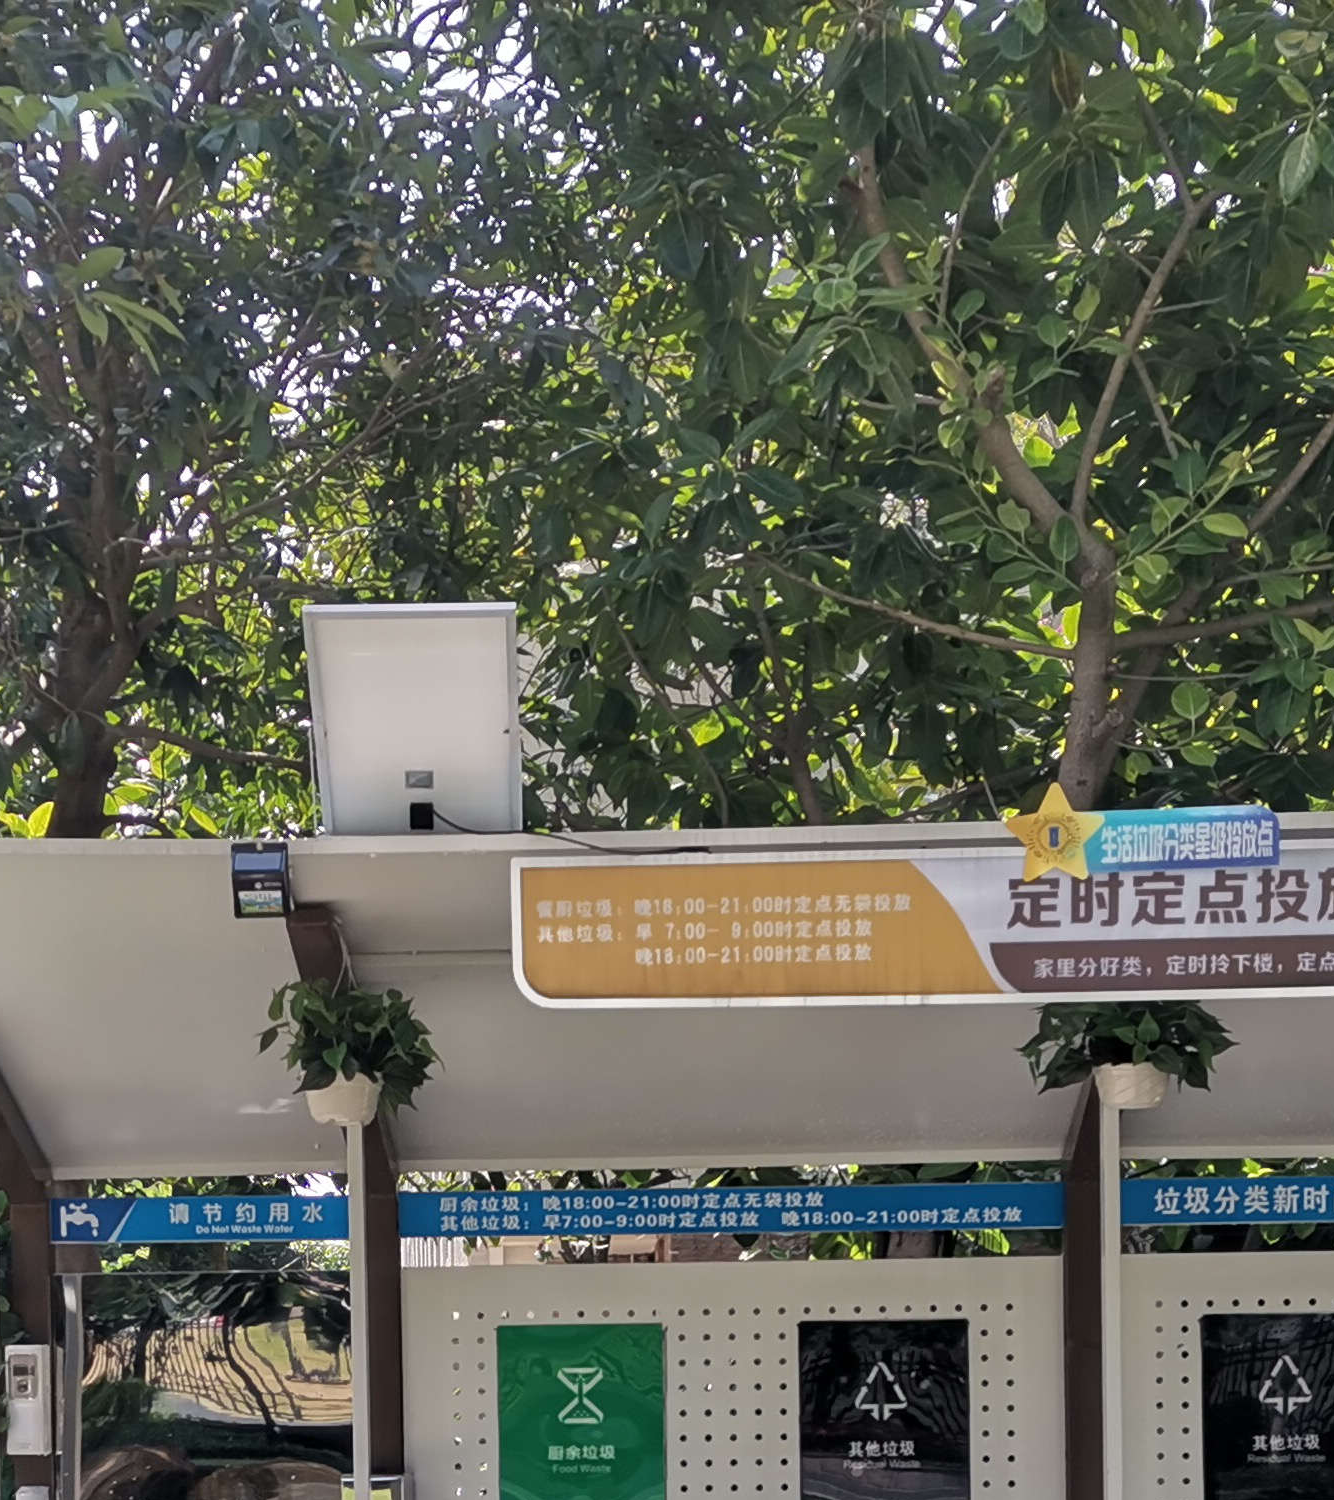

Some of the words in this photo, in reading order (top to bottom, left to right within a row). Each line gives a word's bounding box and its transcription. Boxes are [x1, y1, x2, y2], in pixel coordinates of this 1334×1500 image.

[1101, 818, 1275, 866] 生活垃圾分类星级投放点
[168, 1202, 324, 1225] 请节约用水
[195, 1224, 210, 1235] Do
[212, 1224, 229, 1235] Not
[230, 1224, 263, 1235] Waste
[264, 1223, 294, 1234] Water
[848, 1440, 916, 1457] 其他垃圾
[1252, 1434, 1321, 1452] 其他垃圾
[548, 1445, 616, 1461] 厨余垃圾
[552, 1463, 578, 1474] Food
[580, 1463, 612, 1474] Waste
